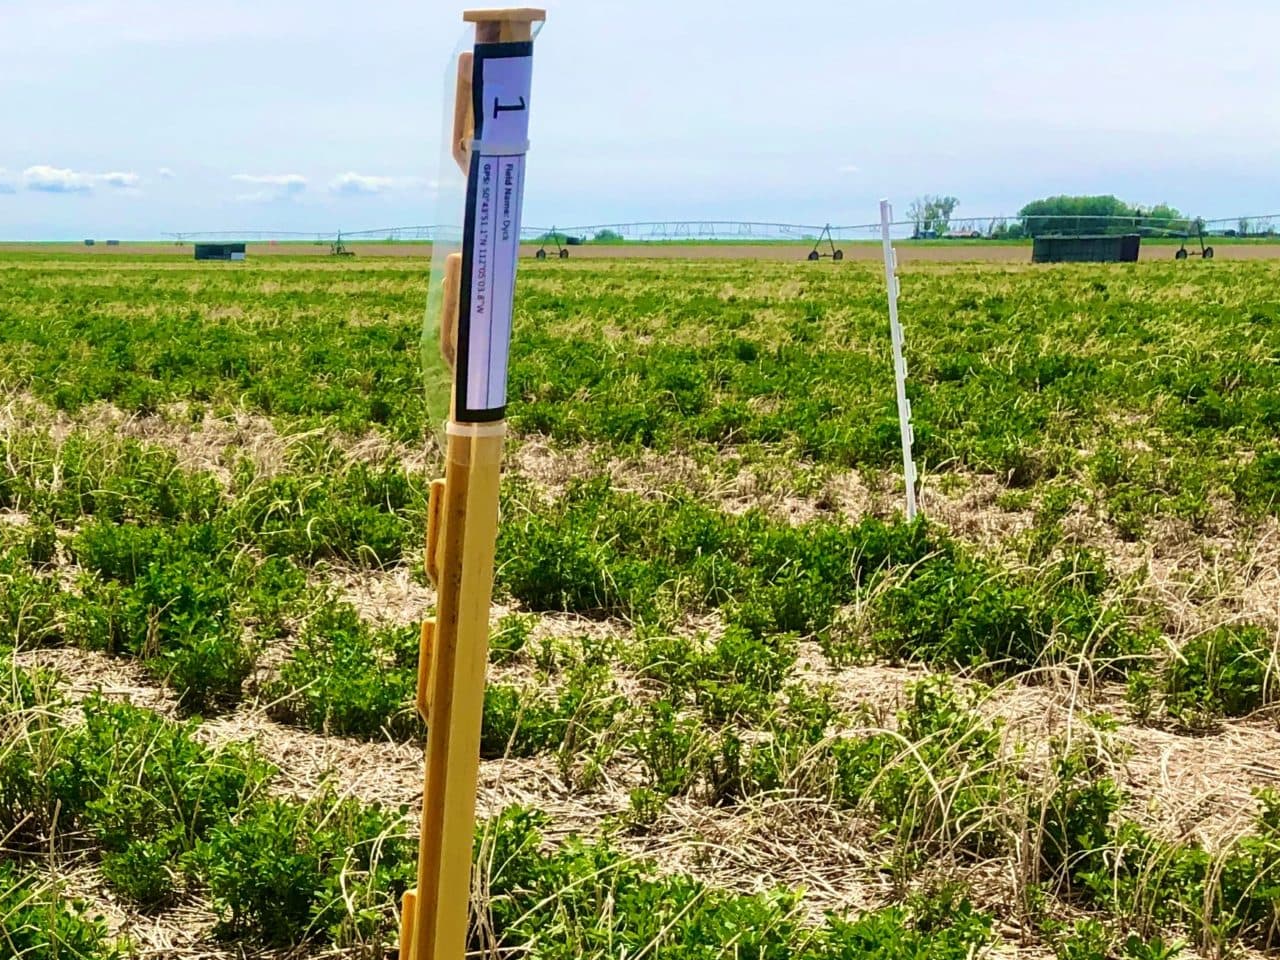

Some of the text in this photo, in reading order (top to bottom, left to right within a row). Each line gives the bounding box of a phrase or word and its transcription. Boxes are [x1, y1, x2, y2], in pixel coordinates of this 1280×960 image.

[493, 96, 526, 119] 1
[482, 163, 492, 185] GPS:
[504, 163, 514, 186] Field
[503, 187, 513, 219] Name:
